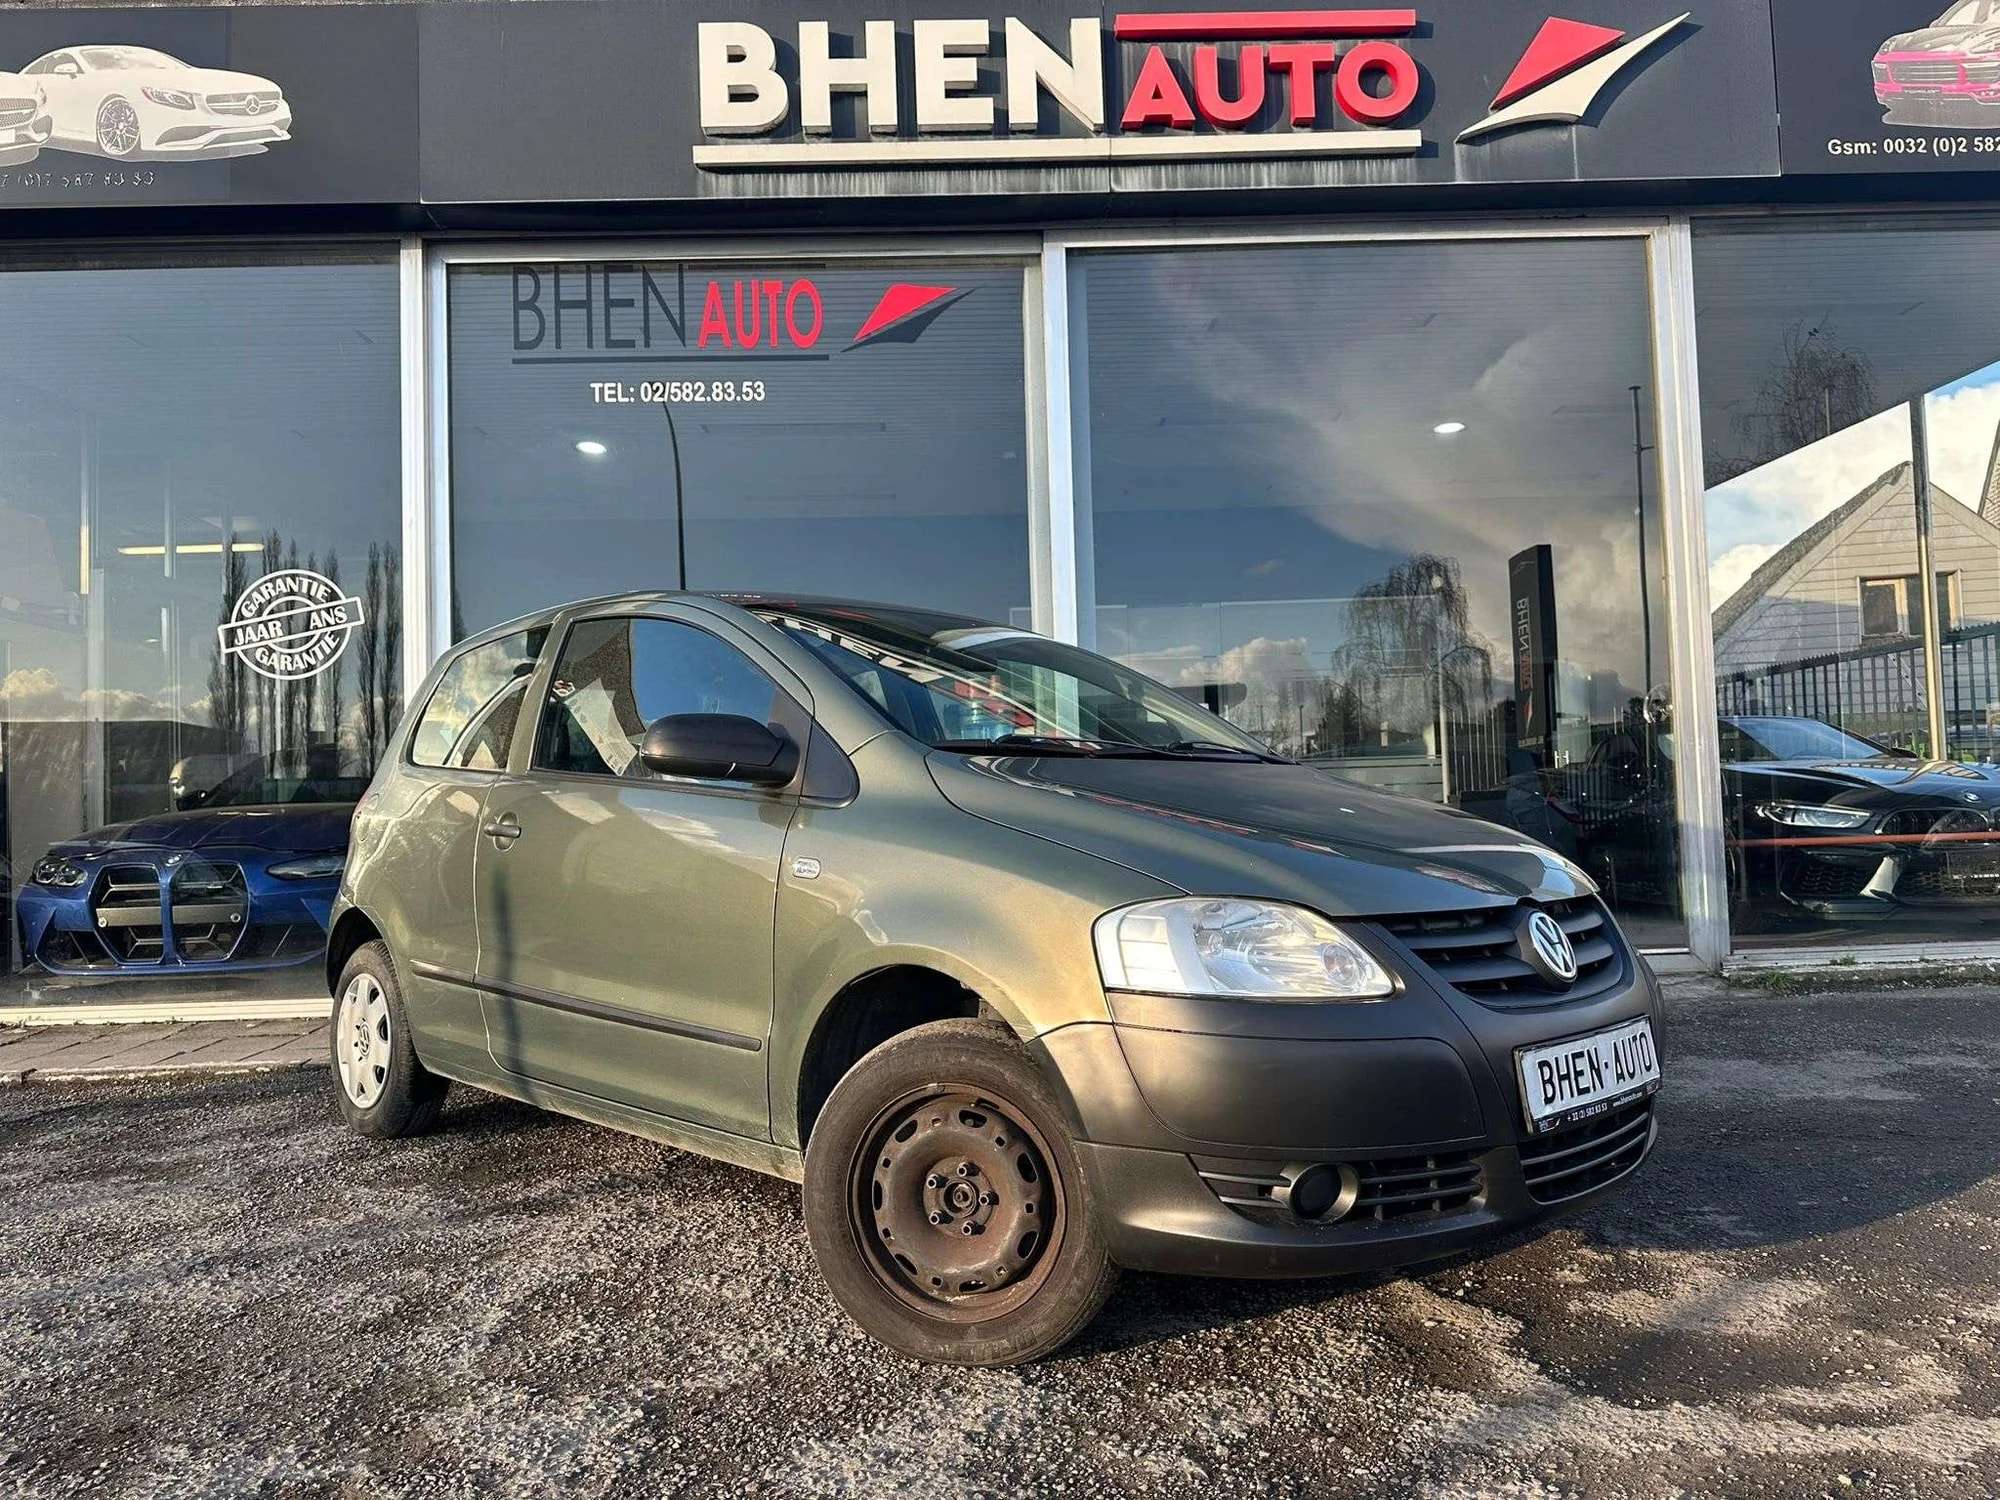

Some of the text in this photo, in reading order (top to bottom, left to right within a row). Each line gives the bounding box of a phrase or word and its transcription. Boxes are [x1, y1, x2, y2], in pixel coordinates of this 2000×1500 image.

[699, 17, 1419, 137] BHEN AUTO
[1827, 138, 1877, 155] Gsm:
[1884, 138, 1927, 154] 0032
[1933, 136, 1968, 157] (0)2
[511, 263, 824, 350] BHEN AUTO
[590, 381, 766, 403] TEL: 02/582.83.53
[240, 576, 332, 618] GARANTIE
[234, 605, 348, 646] JAAR ANS
[255, 630, 340, 671] GARANTIE
